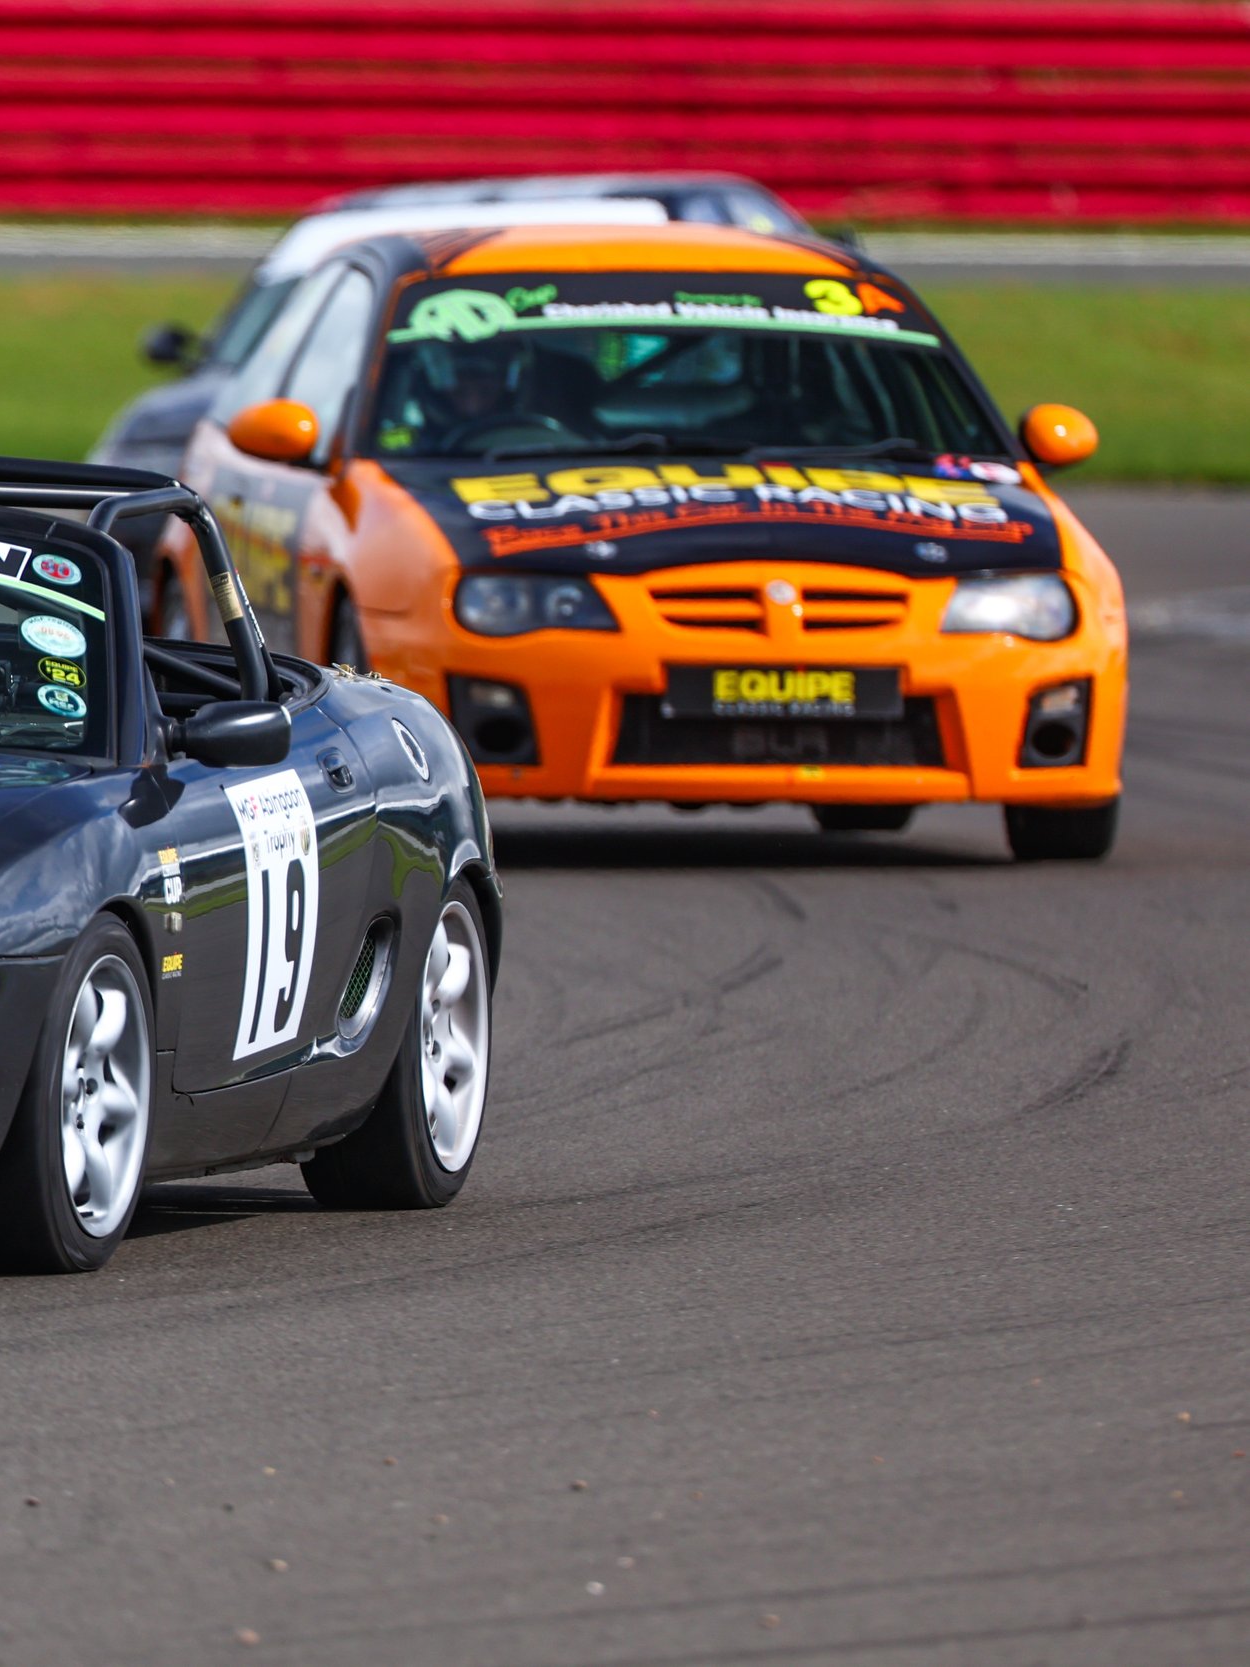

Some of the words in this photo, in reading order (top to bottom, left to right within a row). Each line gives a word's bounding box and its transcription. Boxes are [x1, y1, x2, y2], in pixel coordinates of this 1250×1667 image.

[450, 464, 999, 506] EQUIPE
[468, 483, 737, 520] CLASSIC
[753, 484, 1008, 523] RACING
[713, 670, 856, 703] EQUIPE
[264, 825, 295, 860] Trophy
[247, 858, 306, 1045] 19
